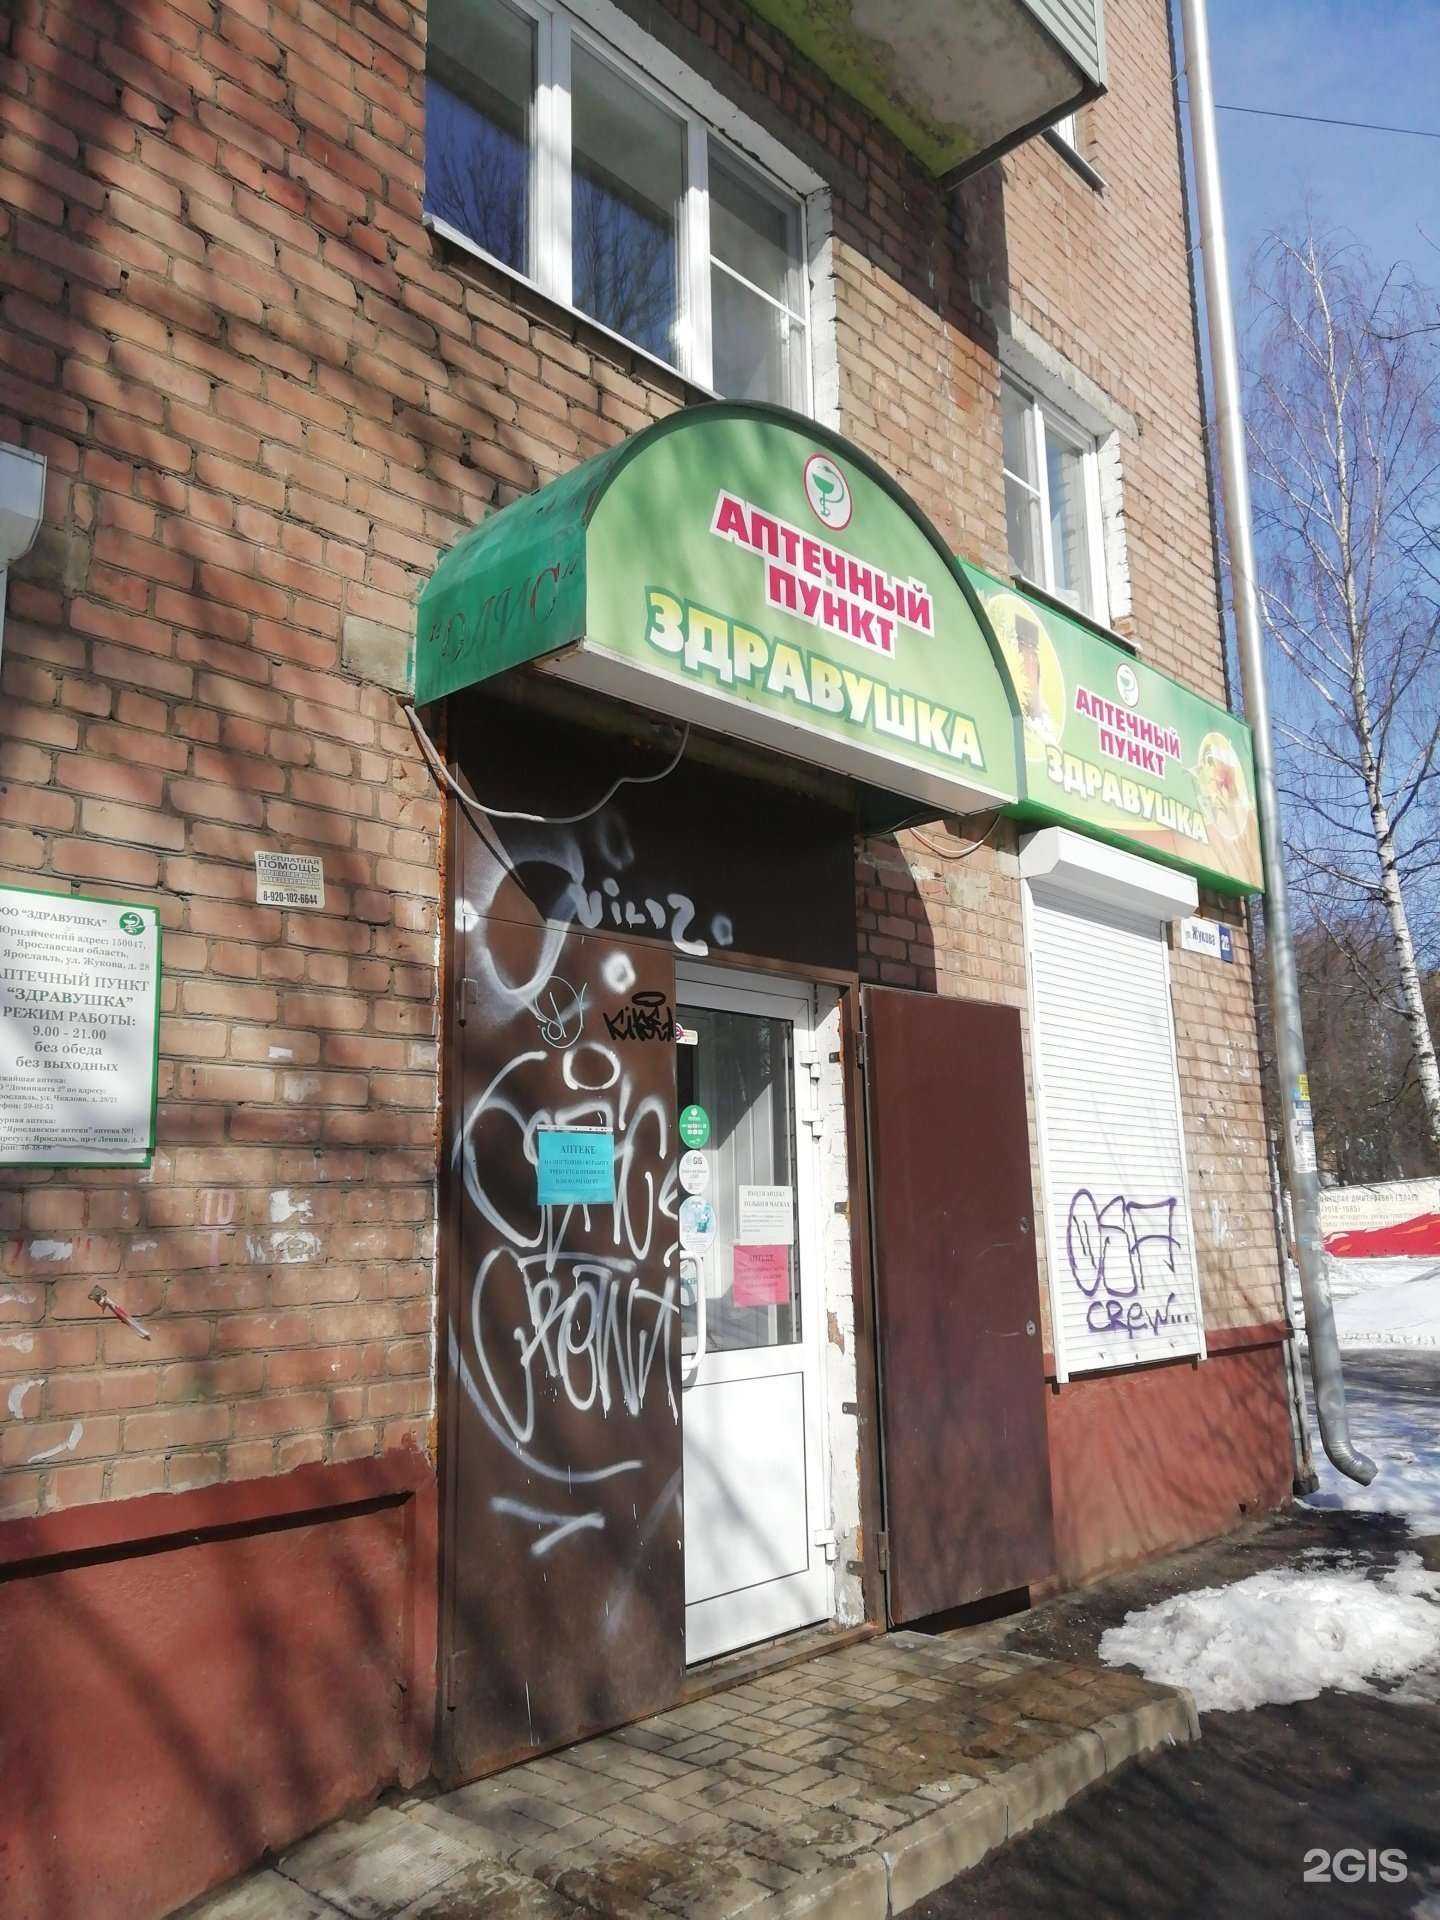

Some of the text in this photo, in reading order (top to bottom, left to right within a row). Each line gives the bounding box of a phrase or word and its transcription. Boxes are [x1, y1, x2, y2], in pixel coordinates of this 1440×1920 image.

[714, 495, 931, 631] АПТЕЧНЫЙ
[768, 564, 894, 652] ПУНКТ
[647, 590, 986, 770] ЗДРАВУШКА
[1075, 687, 1182, 760] АПТЕЧНЫЙ
[1100, 728, 1165, 777] ПУНКТ
[1046, 744, 1209, 844] ЗДРАВУШКА
[258, 859, 320, 874] ПОМОЩЬ
[0, 905, 19, 916] ОО
[16, 939, 85, 954] Ярославская
[95, 976, 150, 992] ПУНКТ
[3, 1005, 137, 1027] РЕЖИМ РАБОТЫ:
[32, 1025, 60, 1038] 9.00
[72, 1027, 107, 1041] 21.00
[34, 1041, 104, 1057] без обеда
[15, 1056, 119, 1073] без выходных
